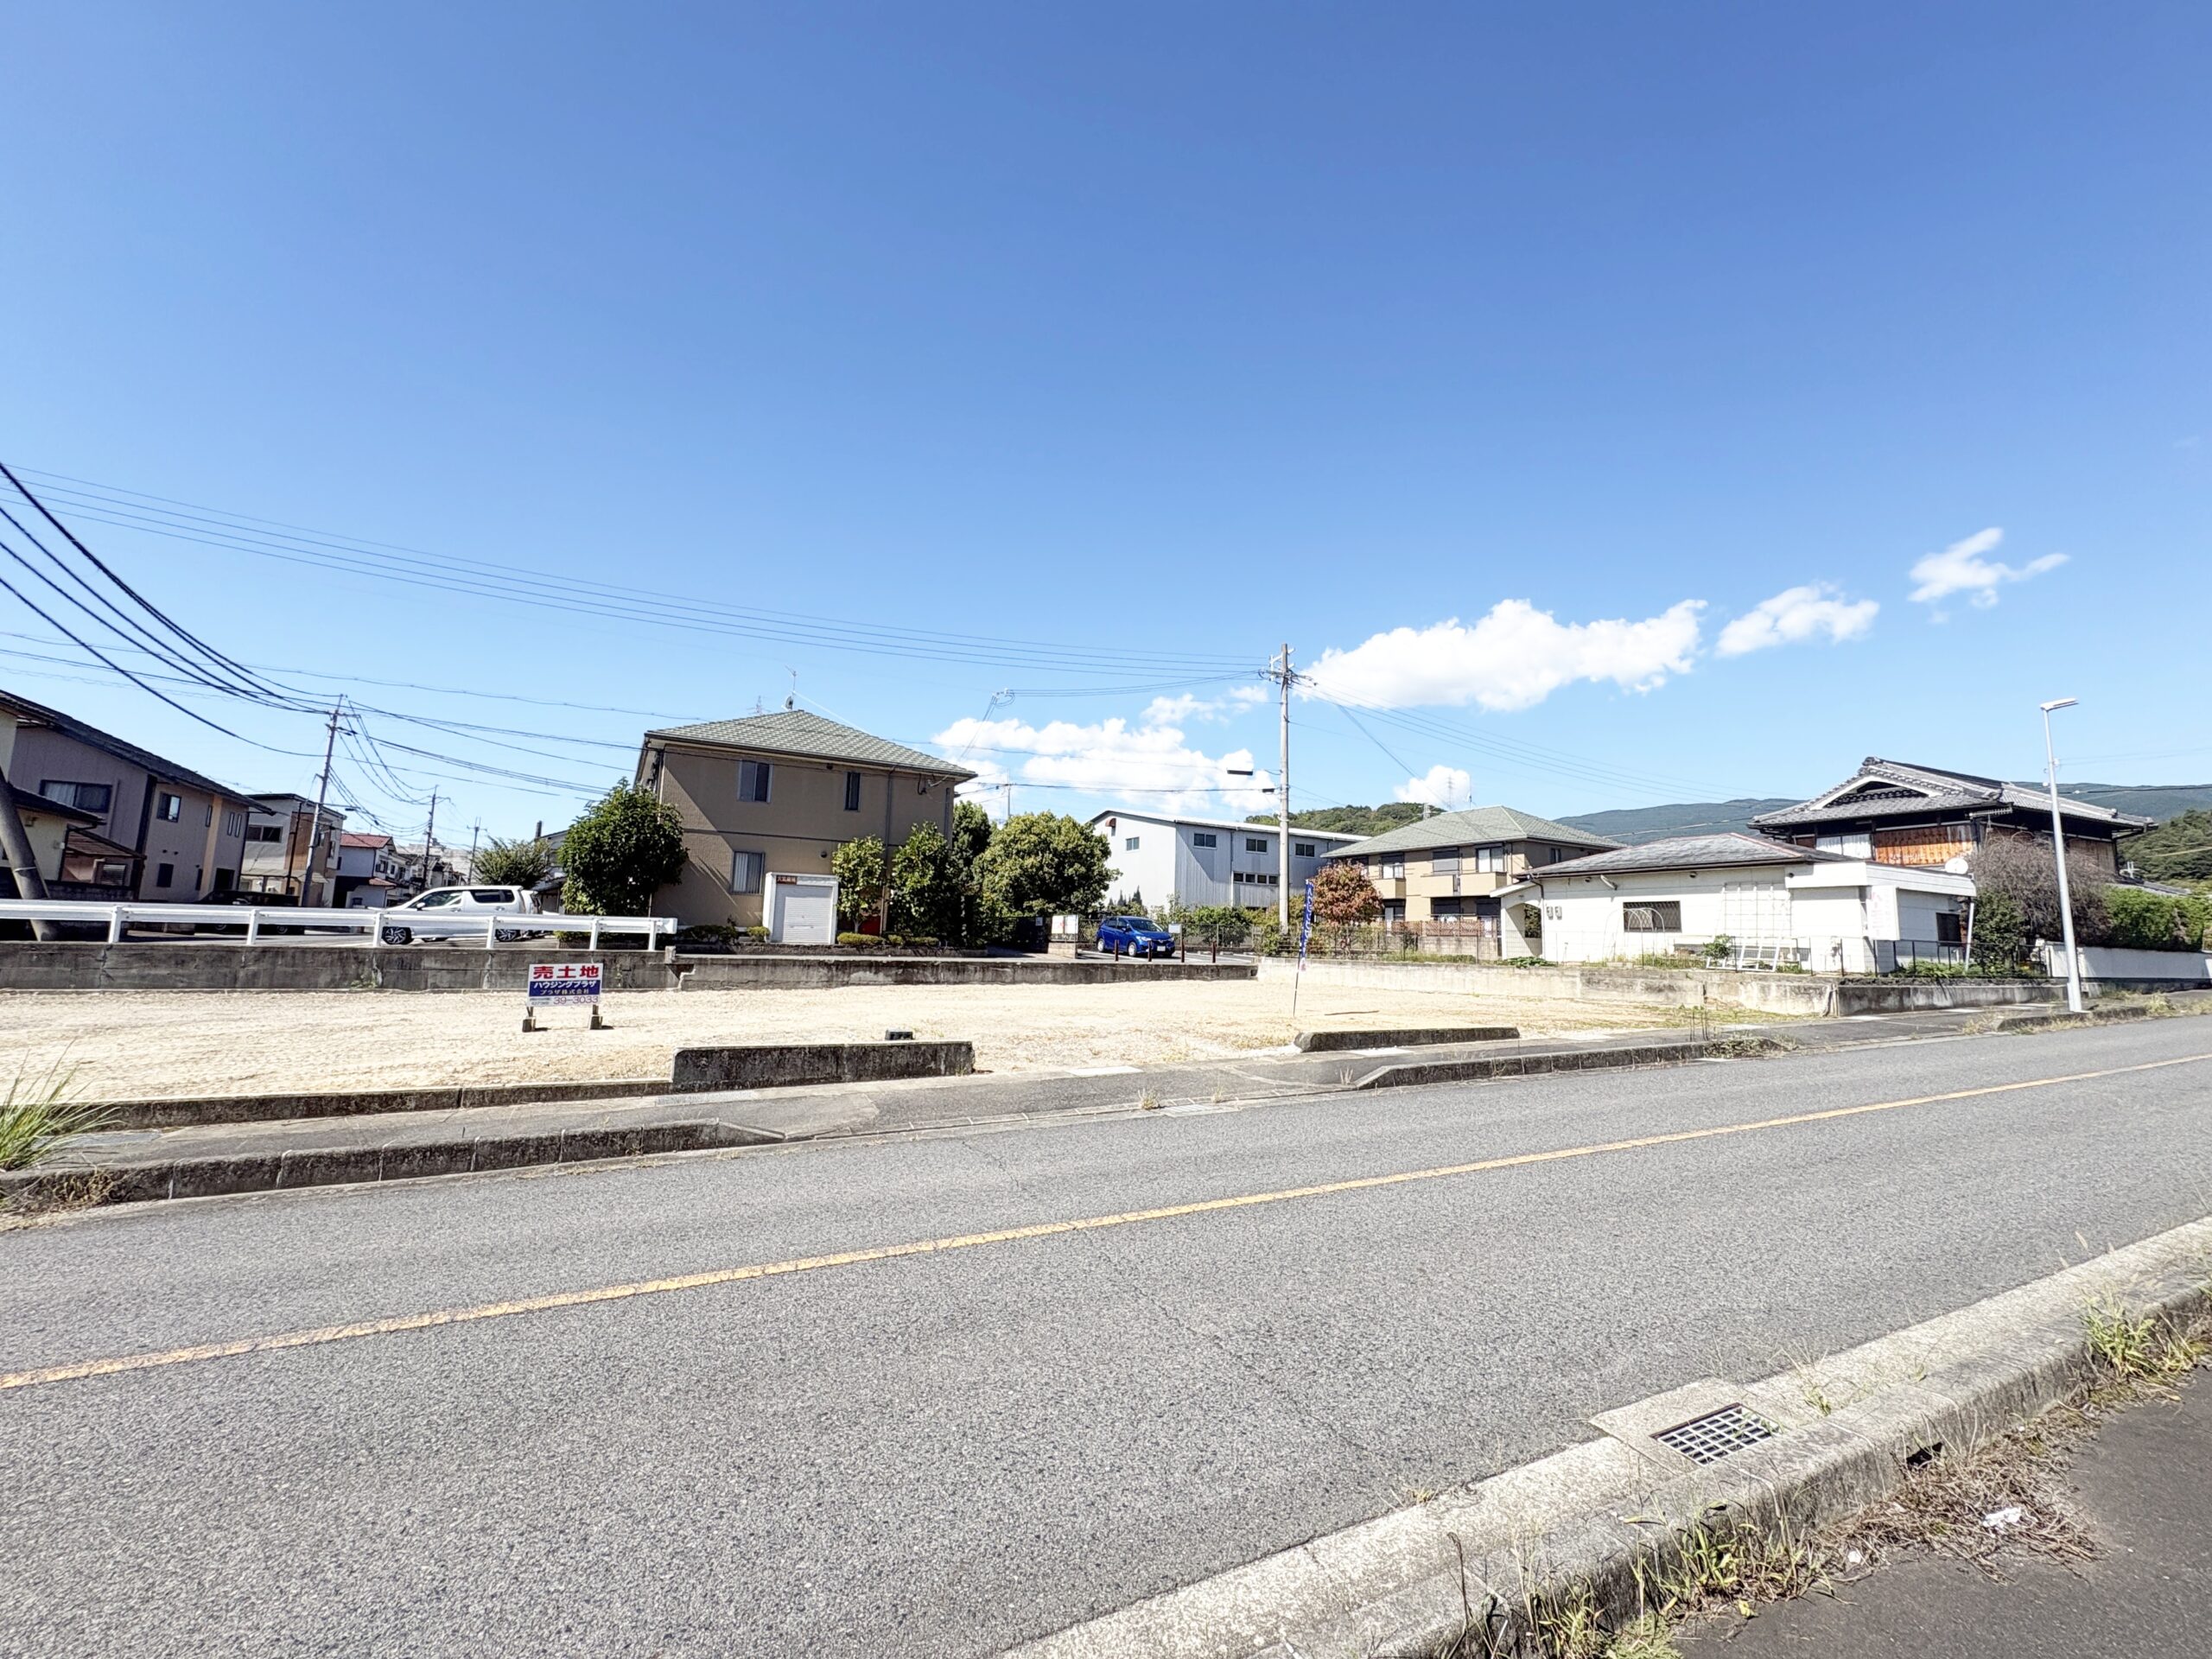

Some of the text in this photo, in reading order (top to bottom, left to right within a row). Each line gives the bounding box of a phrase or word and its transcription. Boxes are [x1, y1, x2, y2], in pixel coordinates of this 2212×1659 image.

[533, 965, 599, 979] 売土地
[533, 980, 597, 988] ハウジングプラザ
